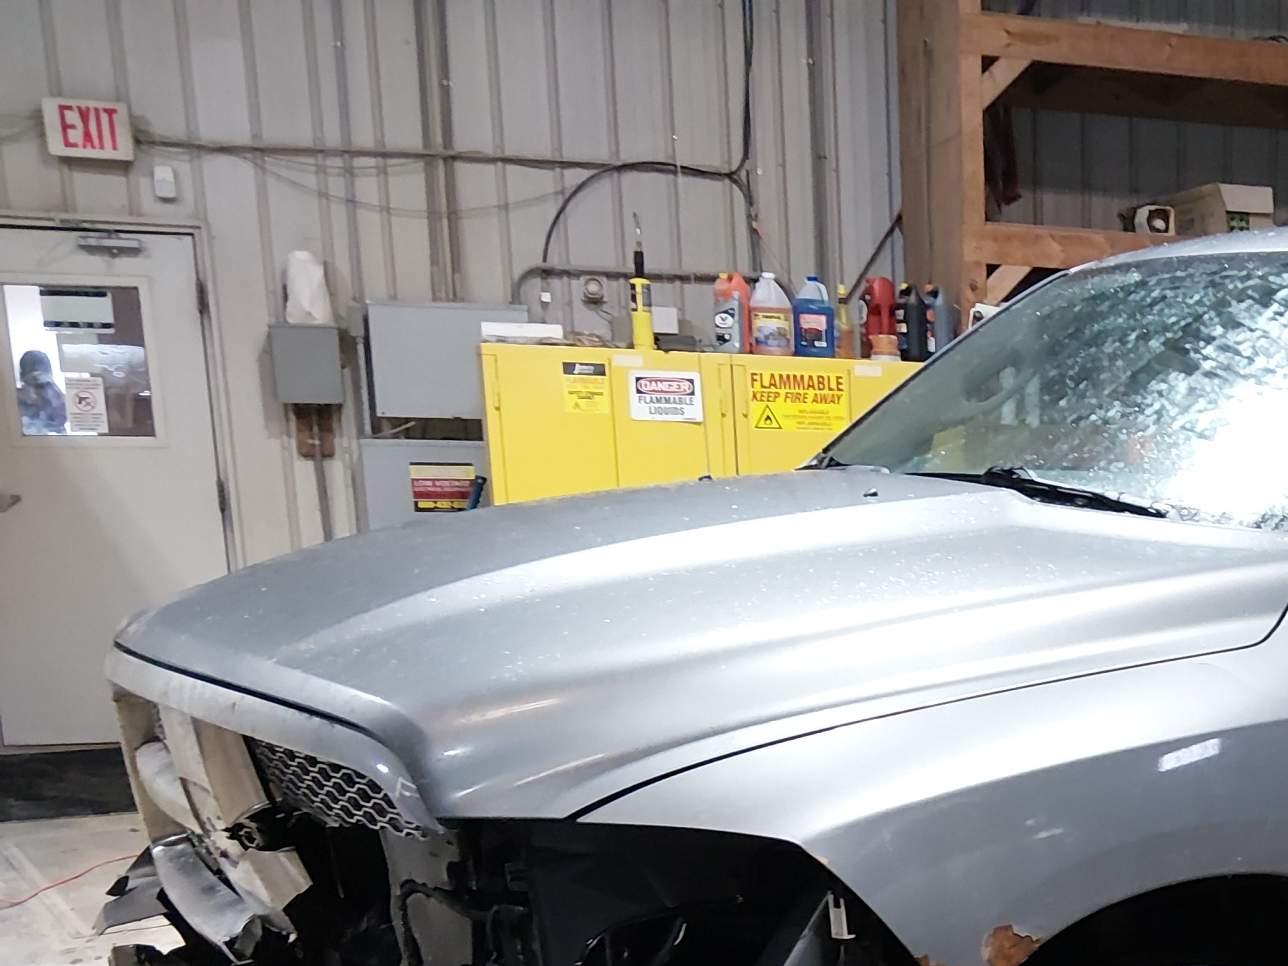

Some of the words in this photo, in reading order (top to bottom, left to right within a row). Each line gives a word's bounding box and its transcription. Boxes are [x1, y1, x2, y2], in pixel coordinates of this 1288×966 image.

[58, 104, 118, 151] EXIT
[641, 380, 688, 393] DANGER
[750, 372, 844, 391] FLAMMABLE
[638, 395, 695, 405] FLAMMABLE
[752, 391, 780, 402] KEEP
[783, 392, 808, 404] FIRE
[811, 393, 843, 405] AWAY
[648, 406, 685, 415] LIQUIDS
